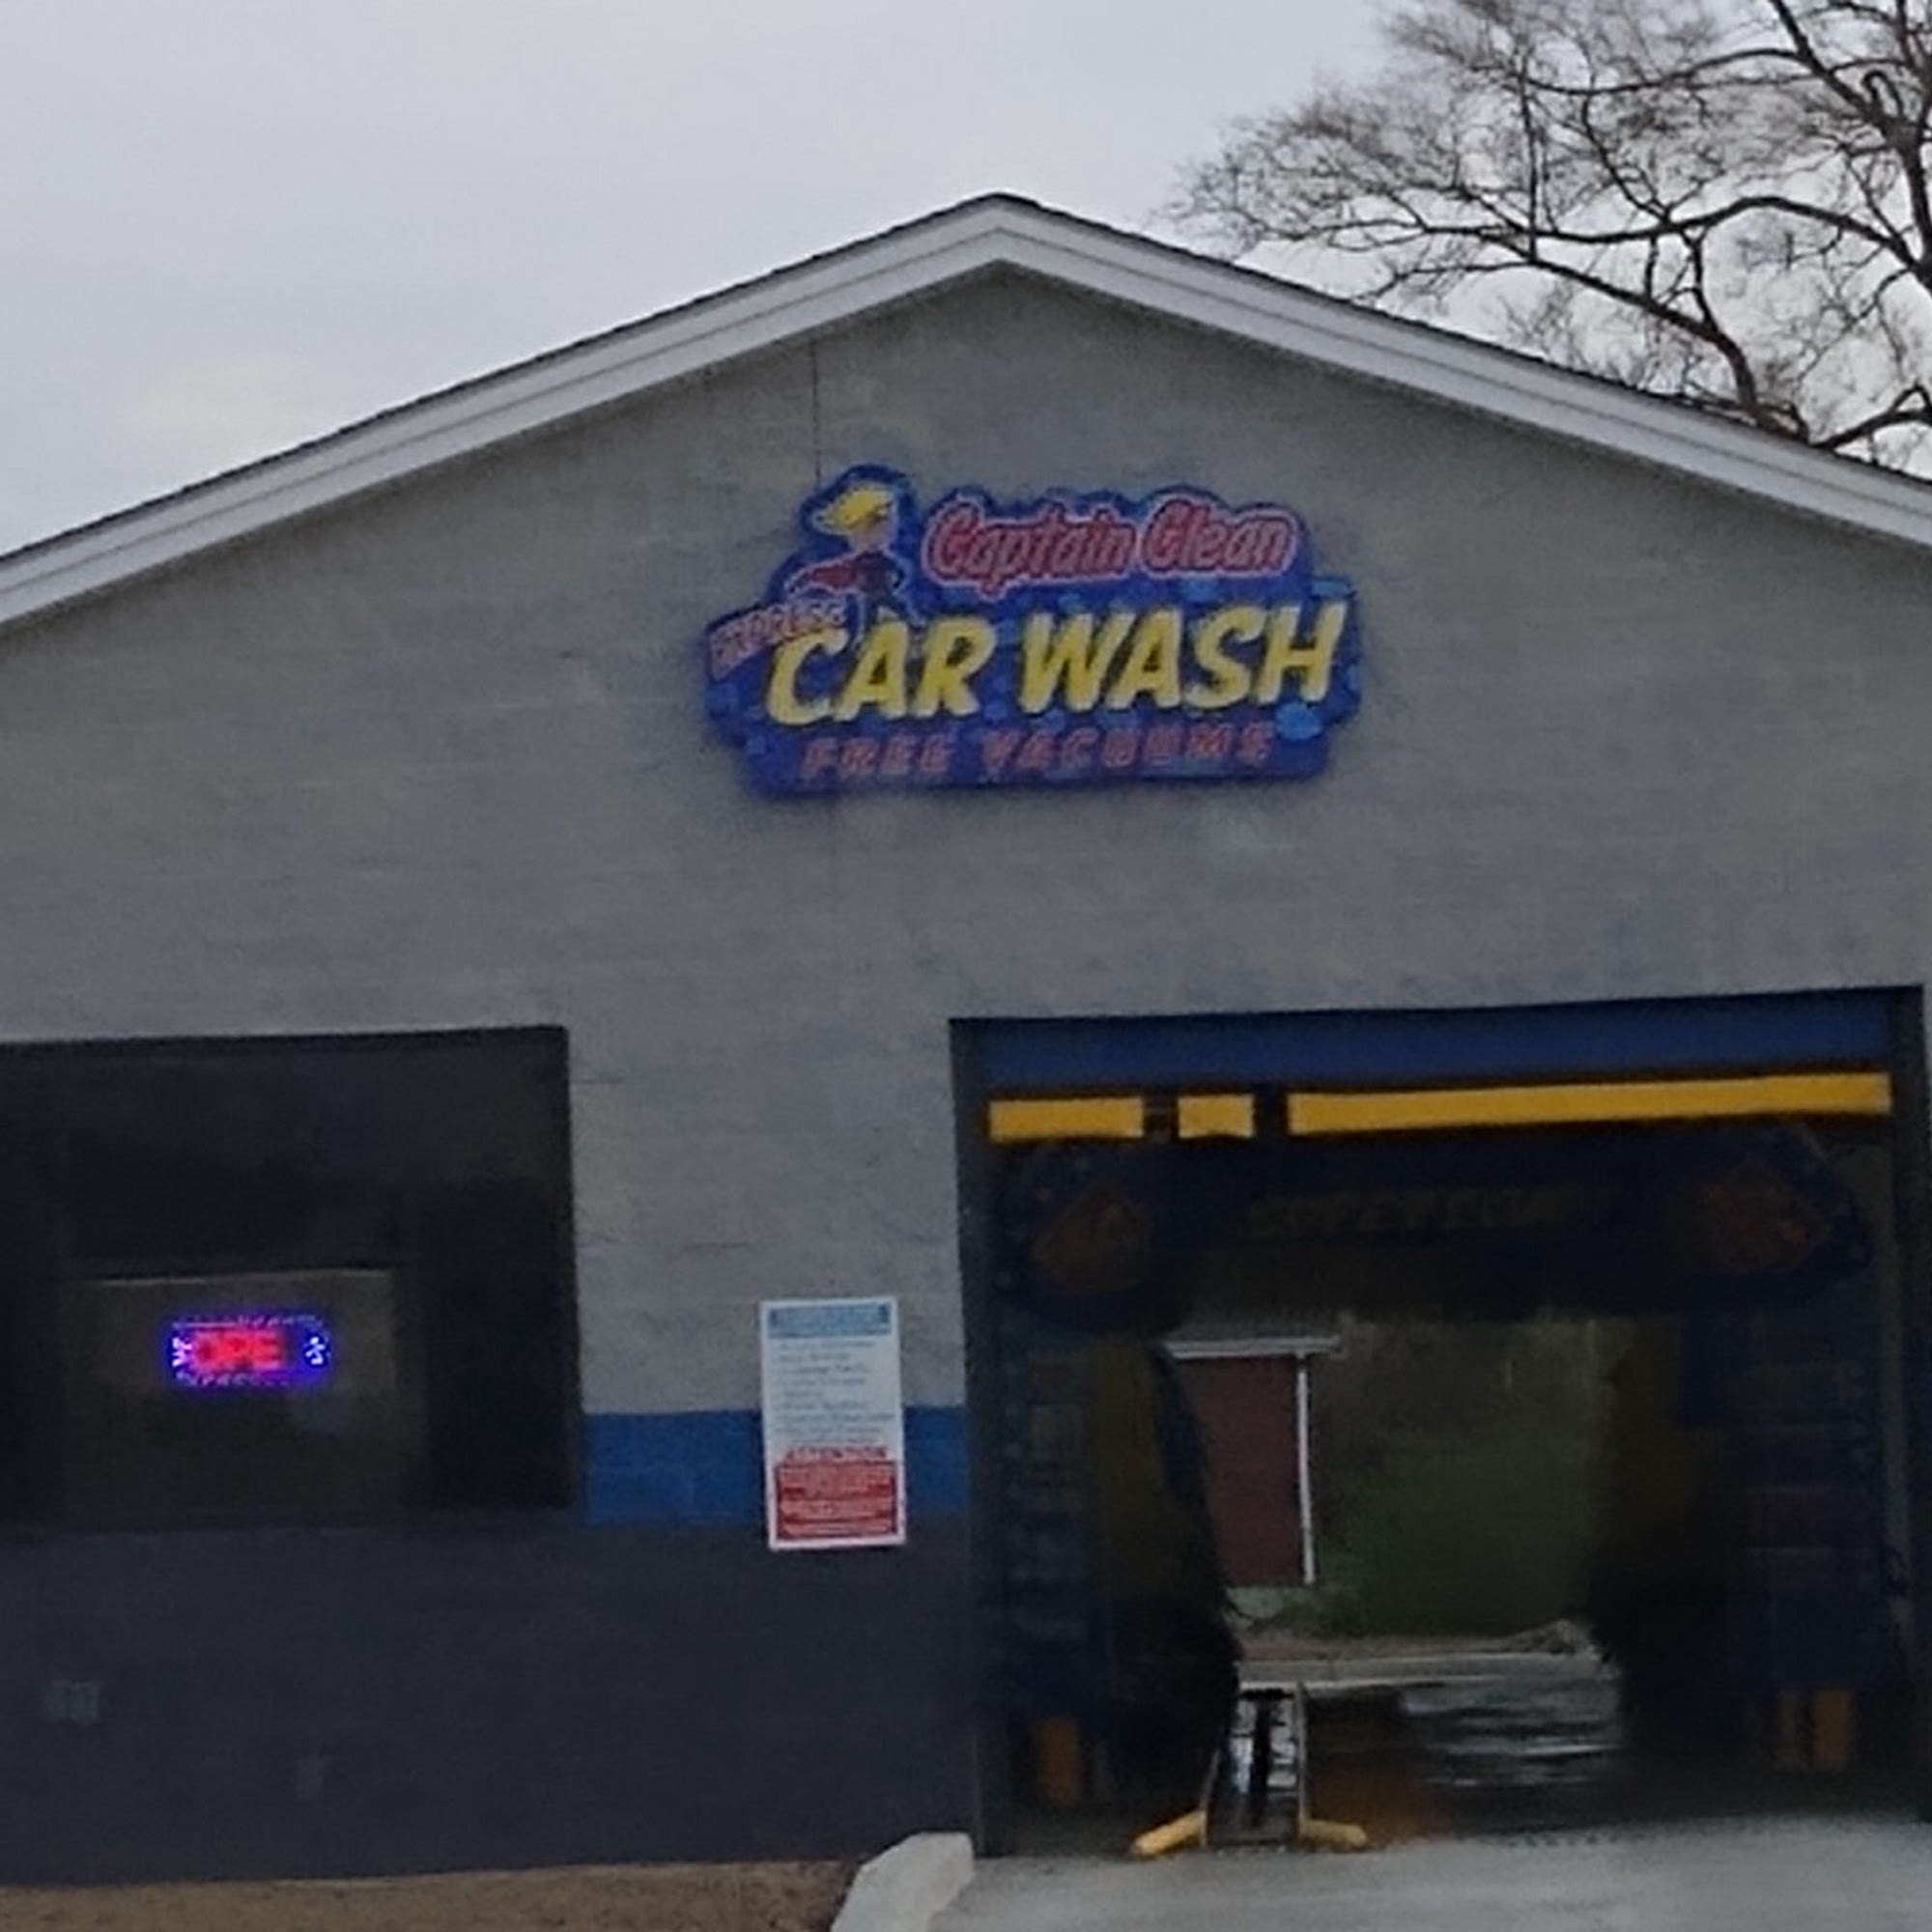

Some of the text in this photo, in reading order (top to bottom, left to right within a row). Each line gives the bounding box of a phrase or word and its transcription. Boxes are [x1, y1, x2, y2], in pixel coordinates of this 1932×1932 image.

[923, 494, 1295, 592] Captain Clean
[765, 601, 1348, 725] CAR WASH
[801, 720, 1275, 777] FREE VACUUMS
